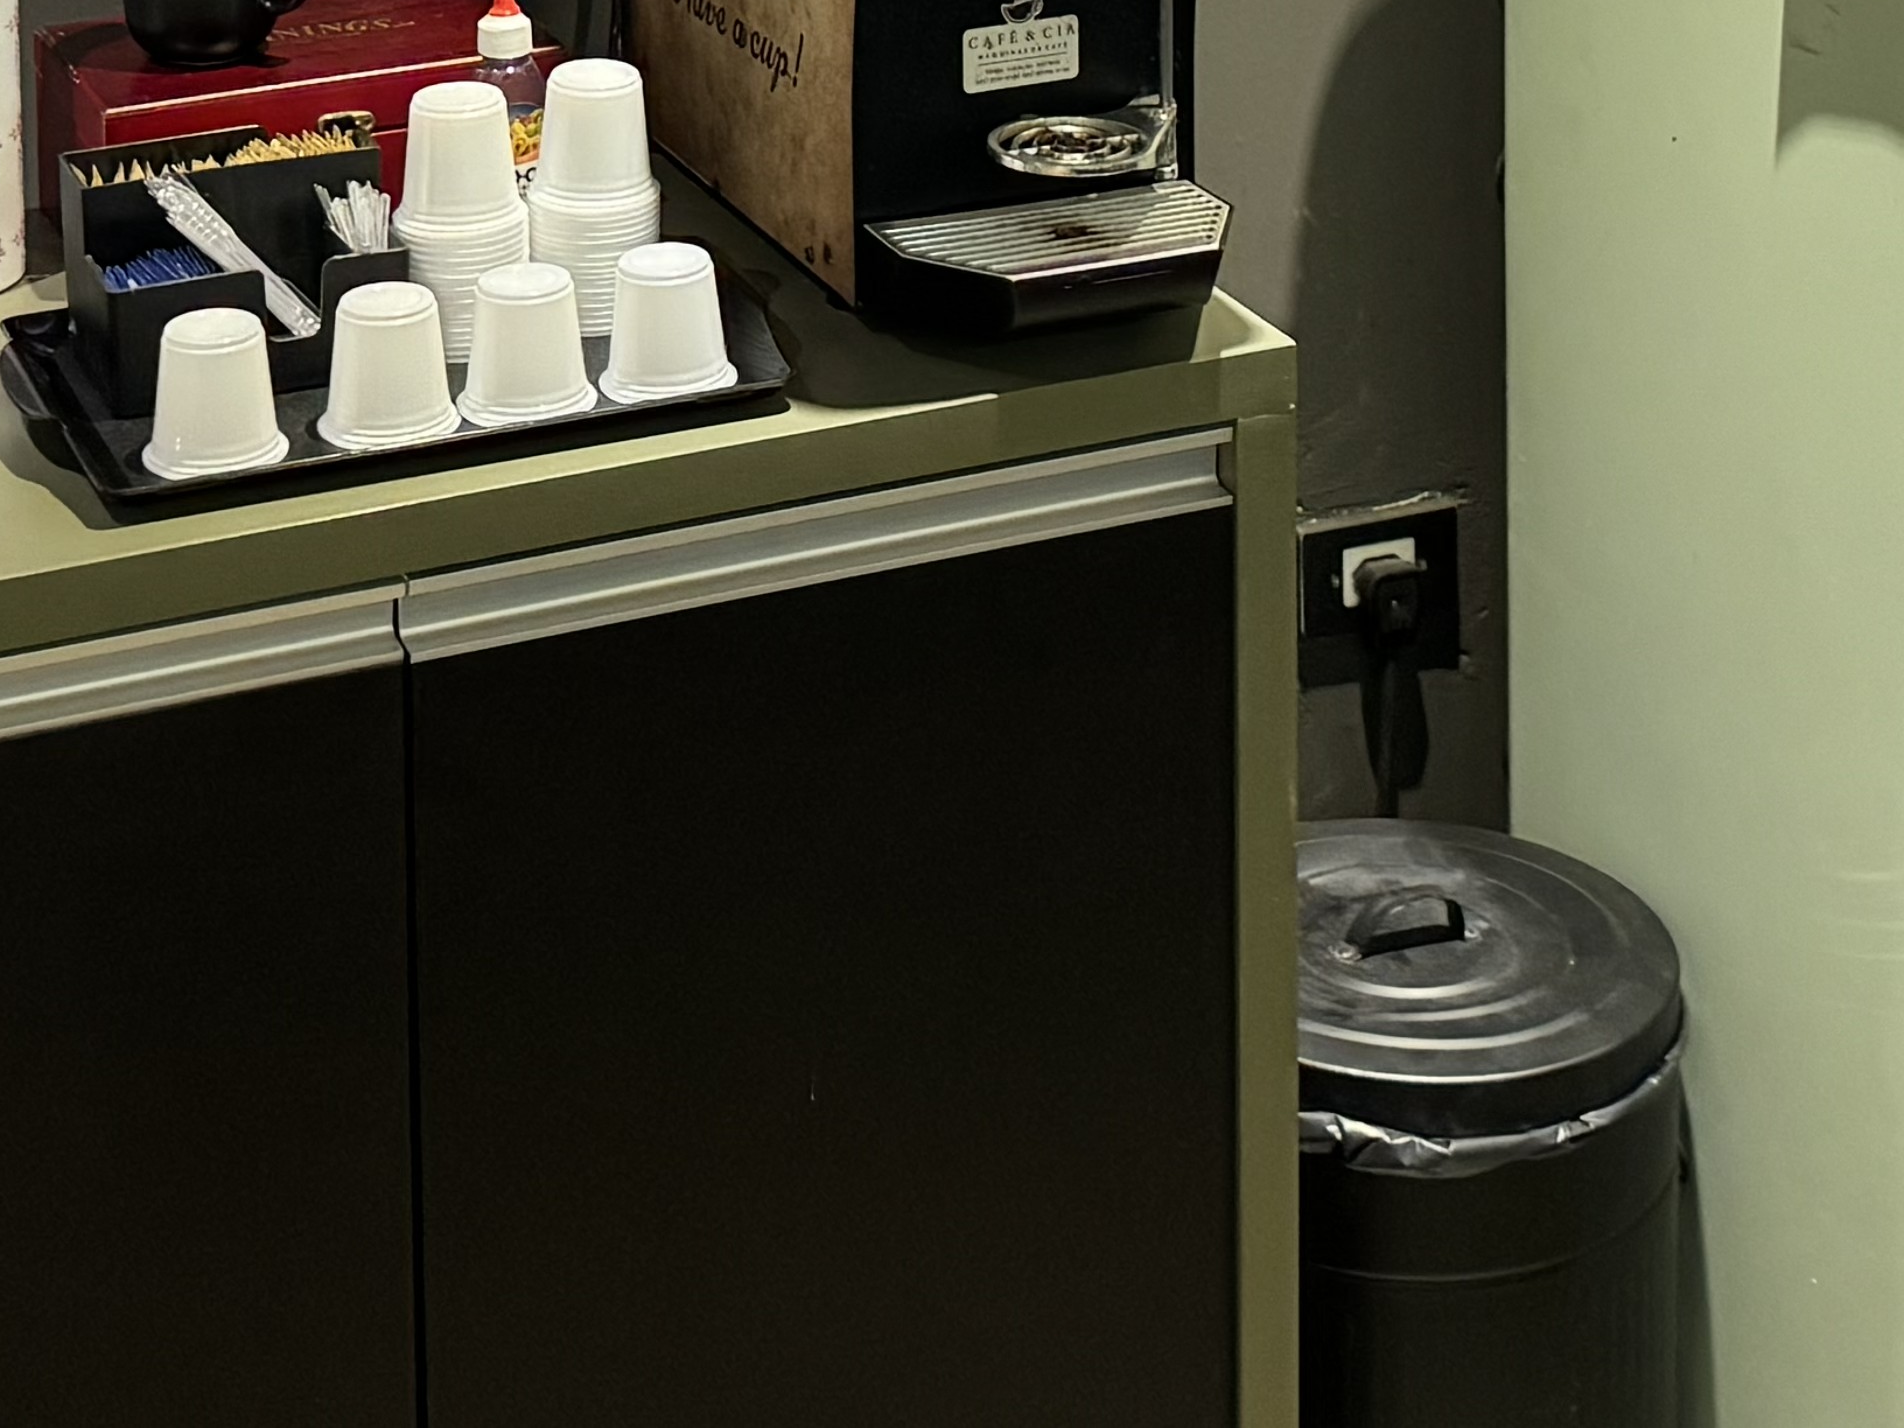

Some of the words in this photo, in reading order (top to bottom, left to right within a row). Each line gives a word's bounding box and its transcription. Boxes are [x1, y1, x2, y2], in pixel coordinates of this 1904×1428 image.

[265, 17, 392, 41] NINGS
[968, 30, 1019, 50] CAFÉ
[1025, 30, 1035, 42] &
[1042, 23, 1075, 39] CIA
[732, 18, 747, 49] a
[749, 31, 805, 93] cup!
